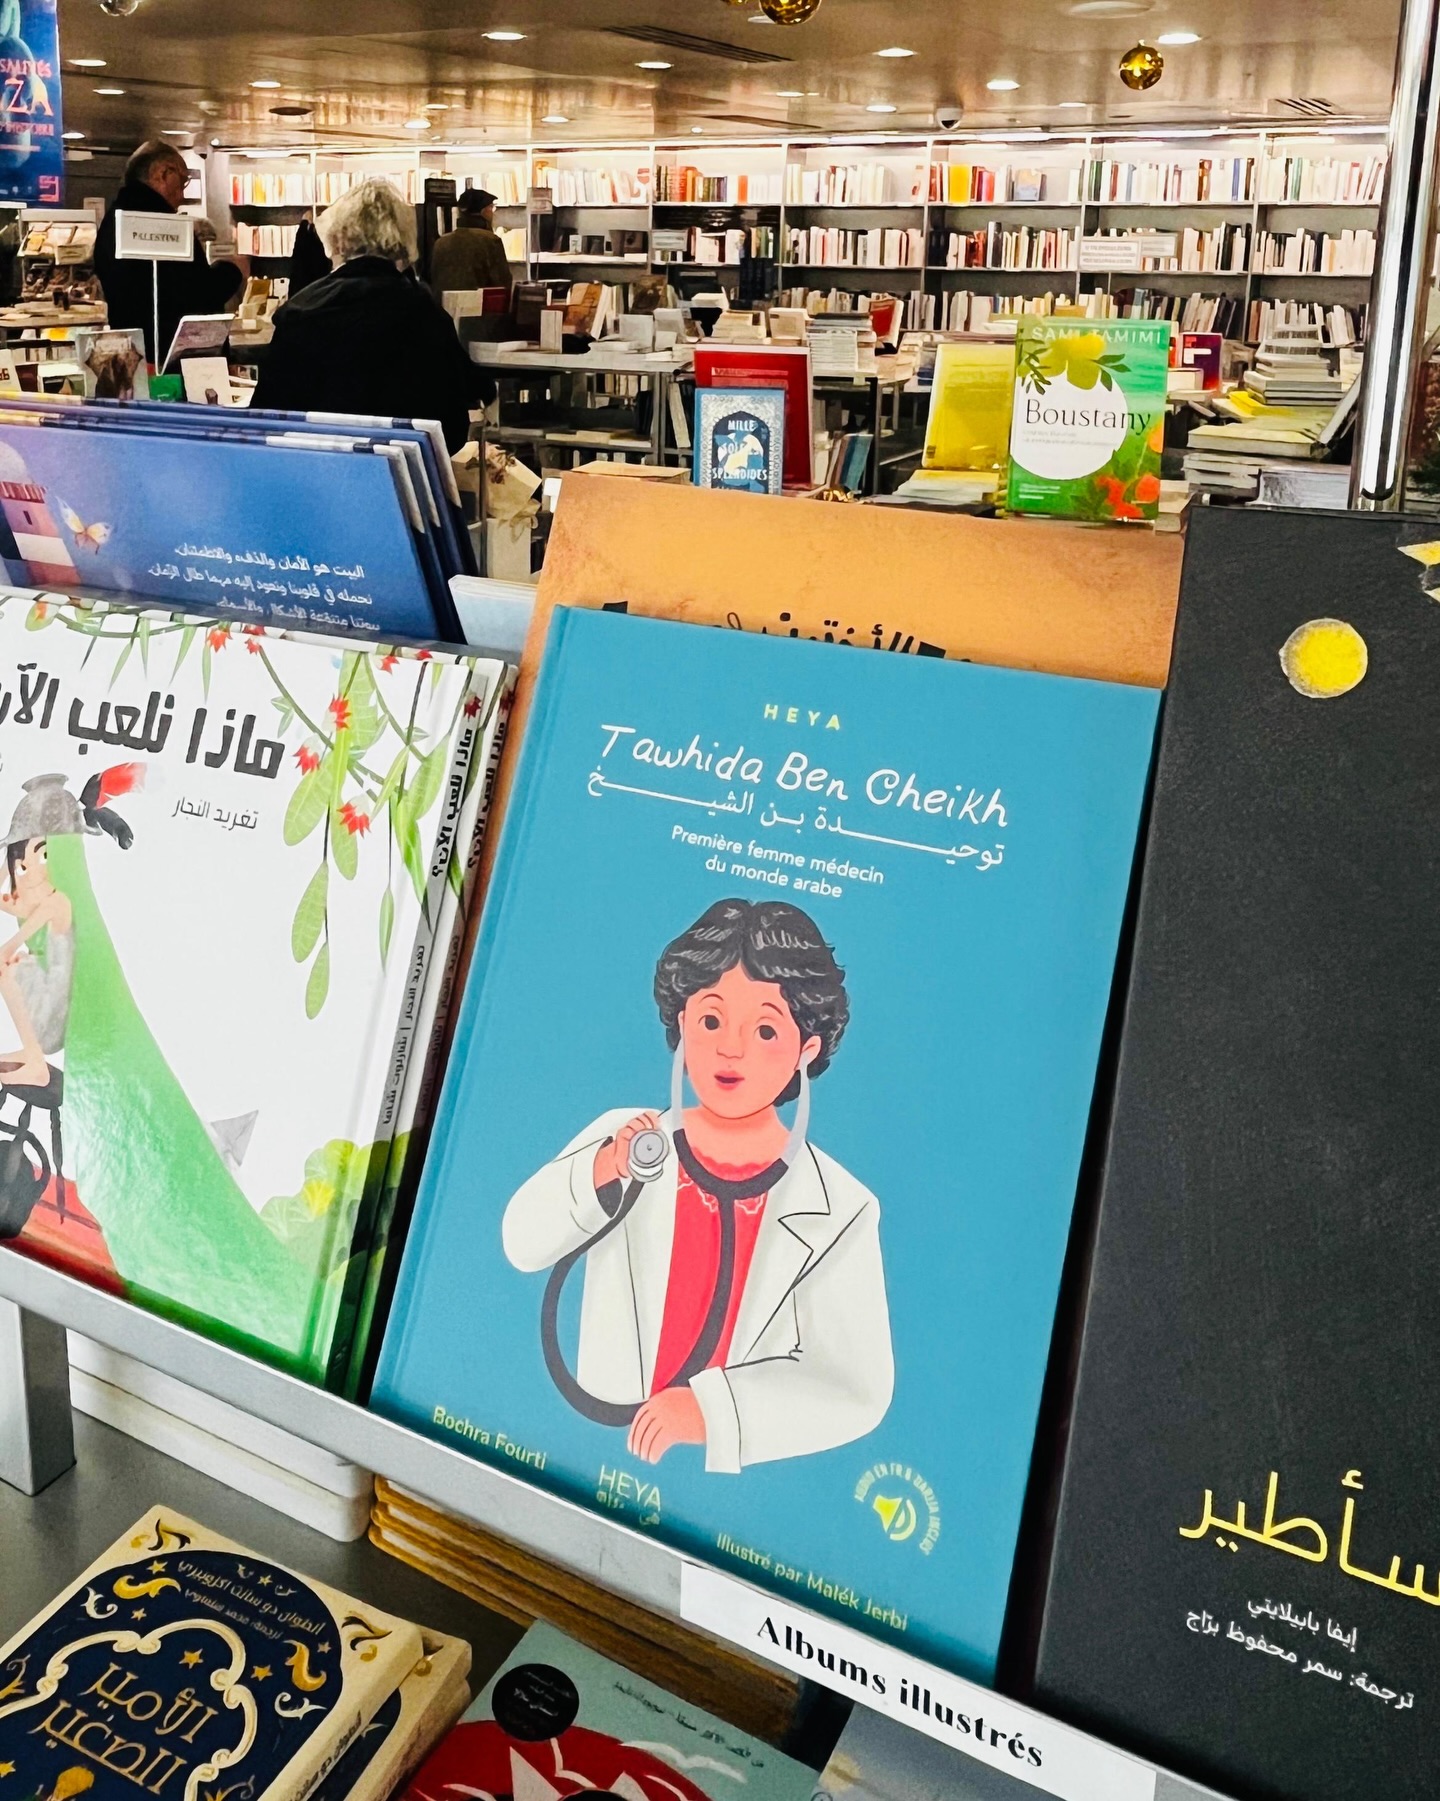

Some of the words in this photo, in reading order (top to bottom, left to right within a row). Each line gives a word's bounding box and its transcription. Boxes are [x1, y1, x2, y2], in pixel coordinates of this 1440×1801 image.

[132, 231, 180, 243] PALESTINE
[1092, 328, 1161, 344] TAMIMI
[727, 419, 757, 432] MILLE
[1026, 399, 1151, 435] Boustany
[182, 567, 204, 582] طال
[205, 568, 232, 587] مهما
[278, 555, 310, 571] الأمان
[313, 563, 331, 576] هو
[332, 565, 365, 579] البيت
[288, 581, 320, 600] قلوبنا
[323, 585, 336, 606] في
[337, 588, 373, 605] نحمله
[0, 662, 60, 729] الآ
[68, 690, 175, 755] نلعب
[764, 703, 841, 730] HEYA
[185, 707, 286, 779] ماذا
[455, 728, 473, 767] ماذا
[587, 765, 754, 816] الشيخ
[601, 724, 763, 784] Tawhida
[776, 751, 848, 801] Ben
[866, 768, 1008, 827] Cheikh
[172, 796, 210, 819] النجار
[447, 774, 464, 820] نلعب
[213, 808, 259, 831] تغريد
[760, 802, 804, 833] بن
[432, 825, 453, 877] الآن؟
[671, 824, 743, 854] Première
[748, 839, 806, 867] femme
[810, 857, 884, 884] médecin
[814, 806, 1005, 871] توحيدة
[705, 854, 726, 873] du
[731, 861, 788, 886] monde
[793, 877, 843, 898] arabe
[411, 945, 425, 984] تغريد
[405, 987, 416, 1021] النجار
[432, 1405, 490, 1445] Bochra
[495, 1432, 547, 1471] Fourti
[599, 1464, 661, 1511] HEYA
[716, 1531, 771, 1571] Illustré
[774, 1557, 803, 1584] par
[807, 1571, 859, 1611] Malék
[862, 1597, 908, 1632] Jerbi
[259, 1602, 279, 1614] دو
[1247, 1599, 1320, 1636] بابيلايتي
[1226, 1621, 1297, 1663] محفوظ
[1326, 1618, 1358, 1653] إيفا
[1301, 1659, 1343, 1681] سمر
[77, 1662, 219, 1744] الأمير
[756, 1615, 887, 1695] Albums
[899, 1677, 1043, 1768] illustrés
[1349, 1672, 1415, 1710] ترجمة:
[27, 1700, 188, 1795] الصغير
